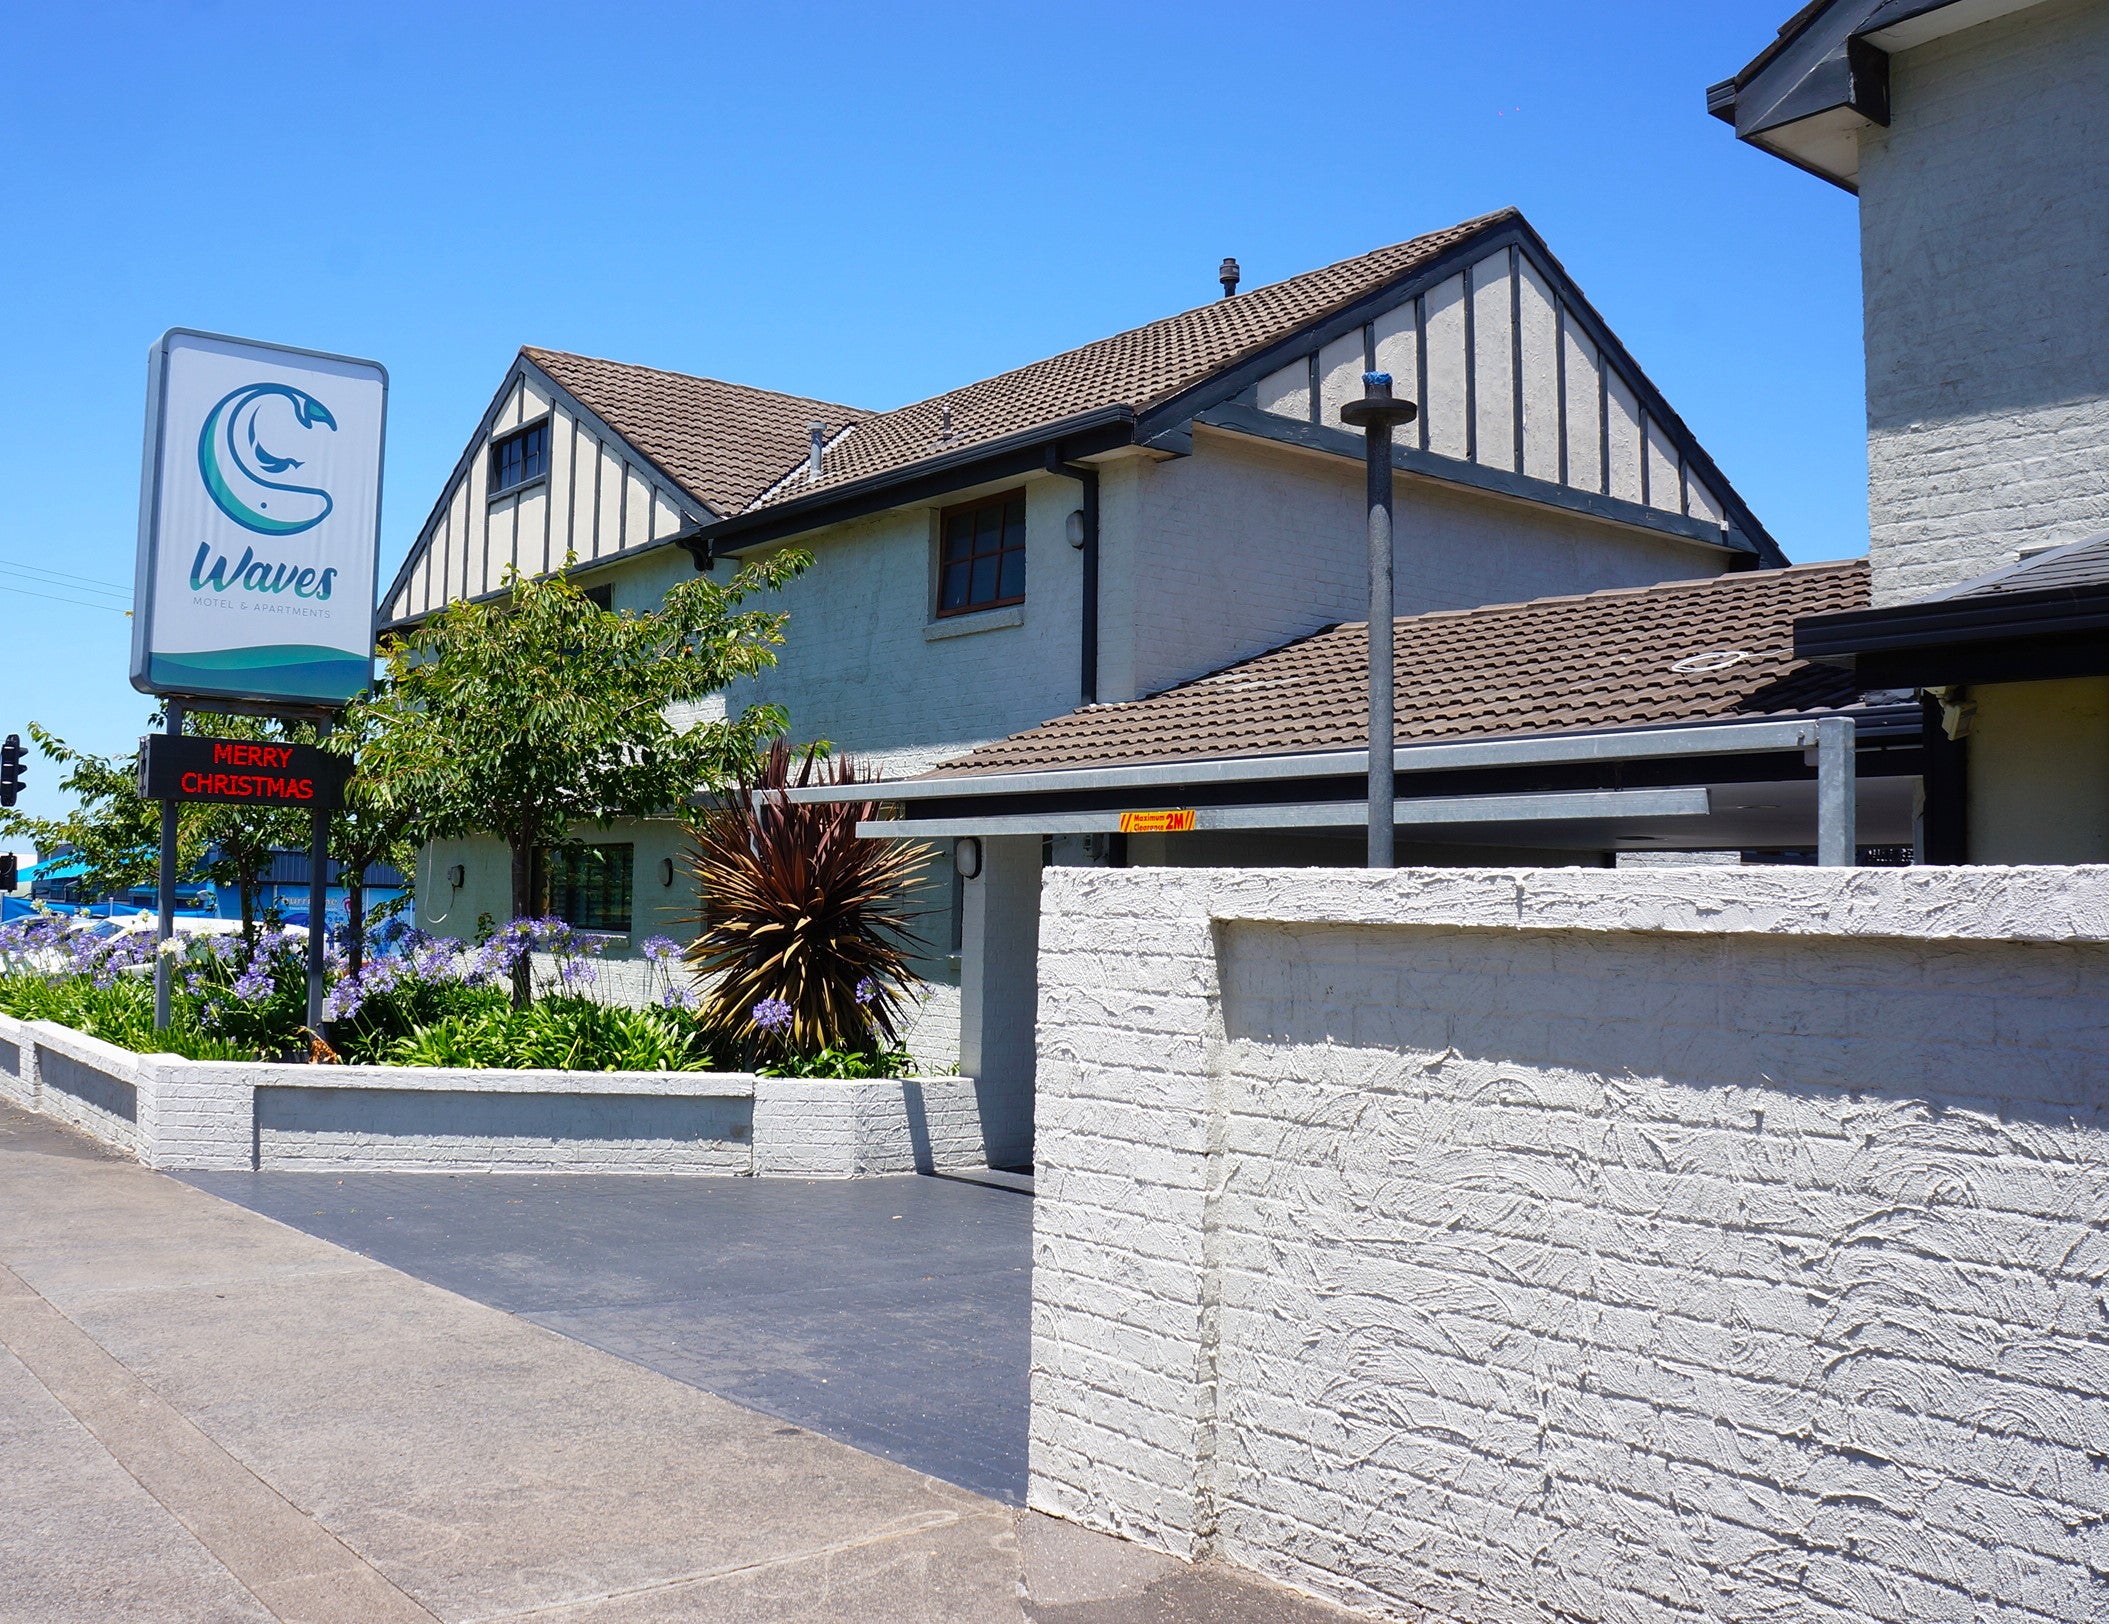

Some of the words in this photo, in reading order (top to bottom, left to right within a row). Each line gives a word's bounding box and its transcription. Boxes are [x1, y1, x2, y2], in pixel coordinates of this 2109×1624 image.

[190, 541, 338, 601] Waves
[193, 597, 234, 609] MOTEL
[240, 602, 248, 610] &
[254, 604, 331, 619] APARTMENTS
[213, 743, 294, 768] MERRY
[181, 771, 314, 799] CHRISTMAS
[1166, 813, 1184, 830] 2M
